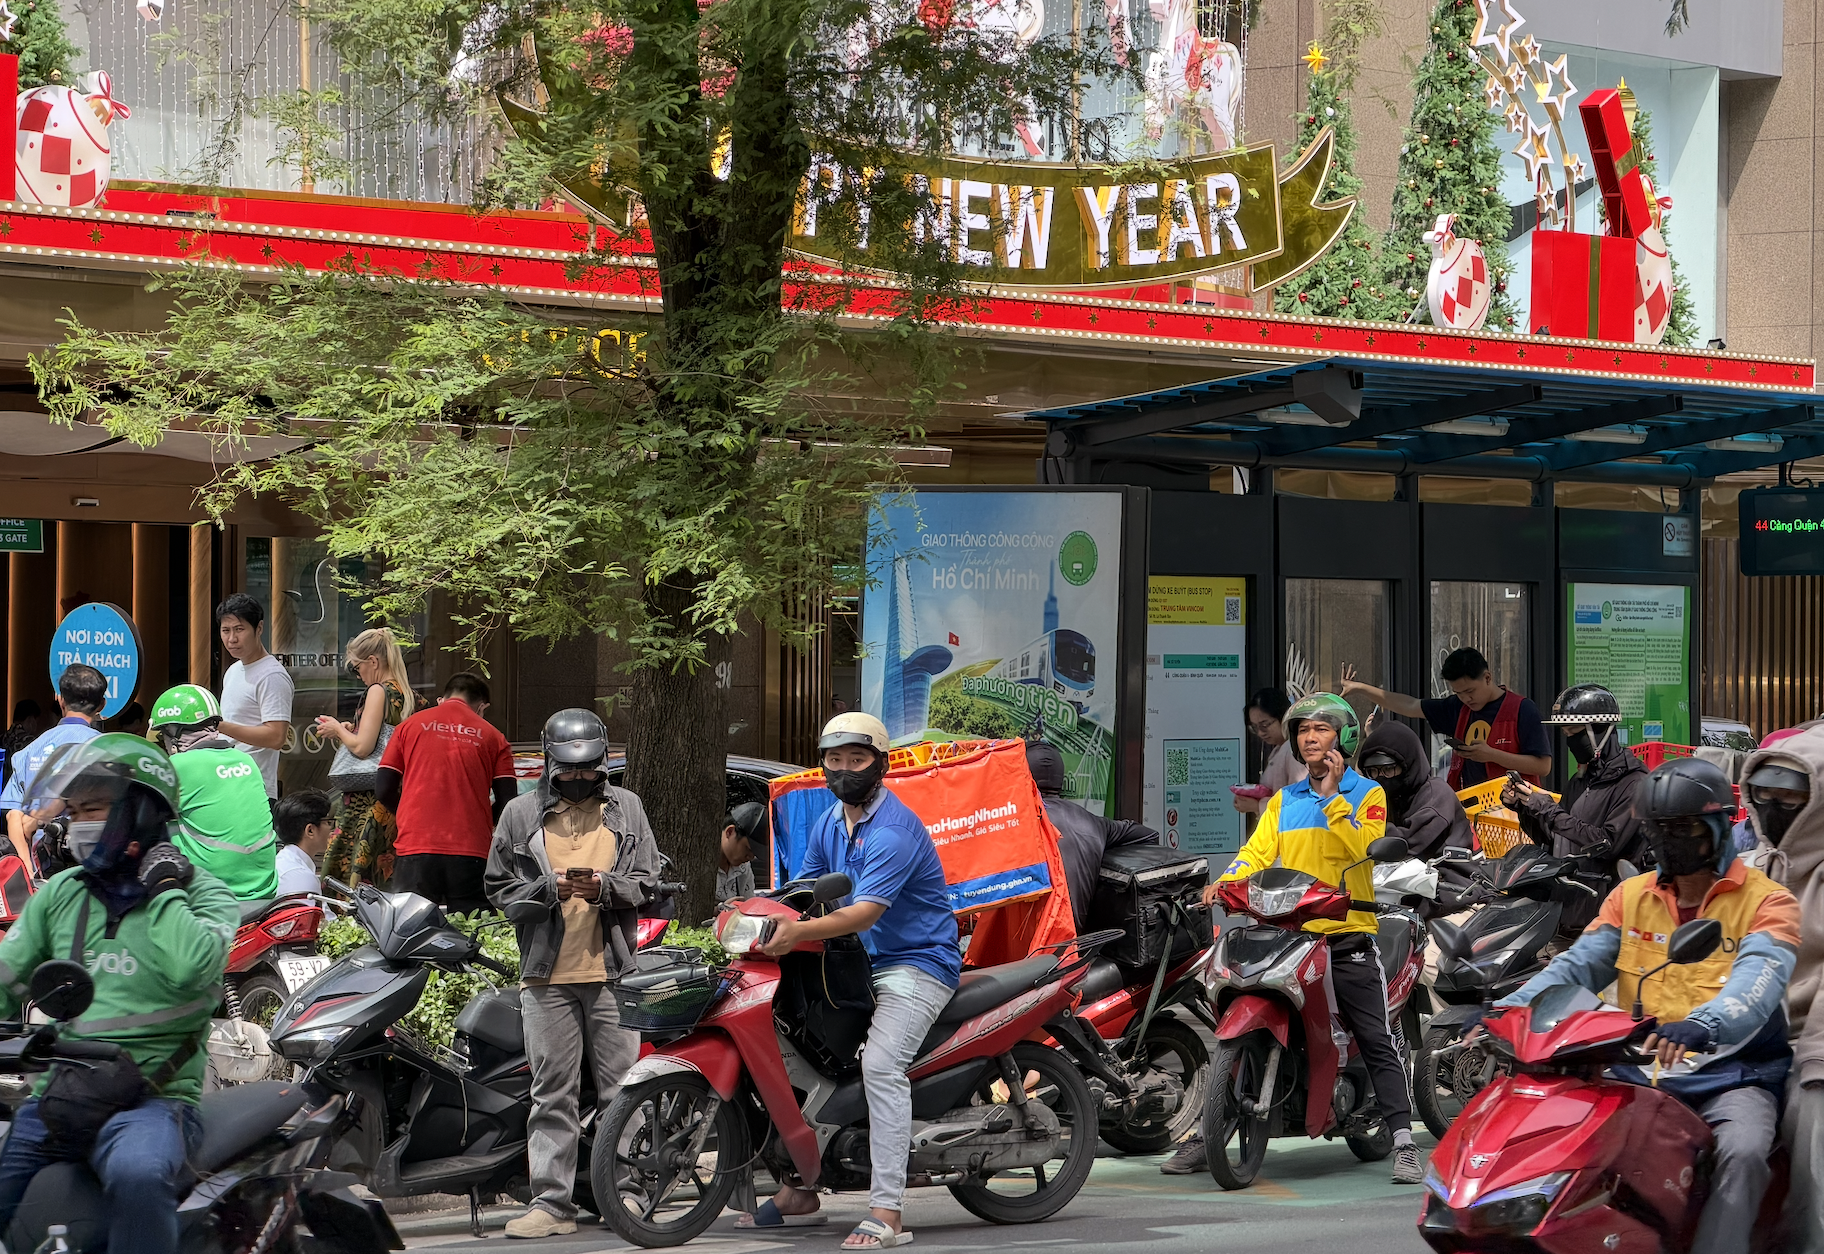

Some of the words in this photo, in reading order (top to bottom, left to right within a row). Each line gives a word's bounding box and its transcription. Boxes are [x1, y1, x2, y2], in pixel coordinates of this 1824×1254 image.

[1072, 171, 1248, 271] YEAR
[0, 518, 25, 526] FFICE
[1755, 519, 1769, 531] 44
[1769, 519, 1793, 533] Cảng
[1794, 518, 1819, 533] Quận
[5, 533, 28, 543] GATE
[921, 533, 948, 548] GIAO
[949, 530, 988, 548] THÔNG
[988, 530, 1021, 548] CÔNG
[1021, 531, 1054, 551] CỘNG
[960, 549, 991, 570] Thành
[932, 563, 958, 590] Hồ
[960, 567, 990, 590] Chí
[995, 568, 1040, 591] Minh
[1167, 587, 1173, 595] XE
[65, 629, 91, 644] NƠI
[94, 627, 124, 646] ĐÓN
[58, 647, 82, 665] TRẢ
[86, 650, 131, 668] KHÁCH
[277, 653, 318, 667] ENTER
[105, 676, 119, 699] XI
[962, 676, 975, 691] Đa
[975, 675, 1026, 707] phương
[1029, 686, 1074, 725] tiện
[157, 705, 182, 718] Grab
[420, 720, 483, 740] viettel
[138, 756, 176, 787] Grab
[215, 761, 252, 779] Grab
[932, 836, 950, 848] Siêu
[950, 832, 975, 843] Nhanh,
[975, 827, 987, 837] Giá
[988, 822, 1005, 834] Siêu
[1006, 818, 1020, 829] Tốt
[963, 875, 1033, 898] tuyendung.ghn.vn
